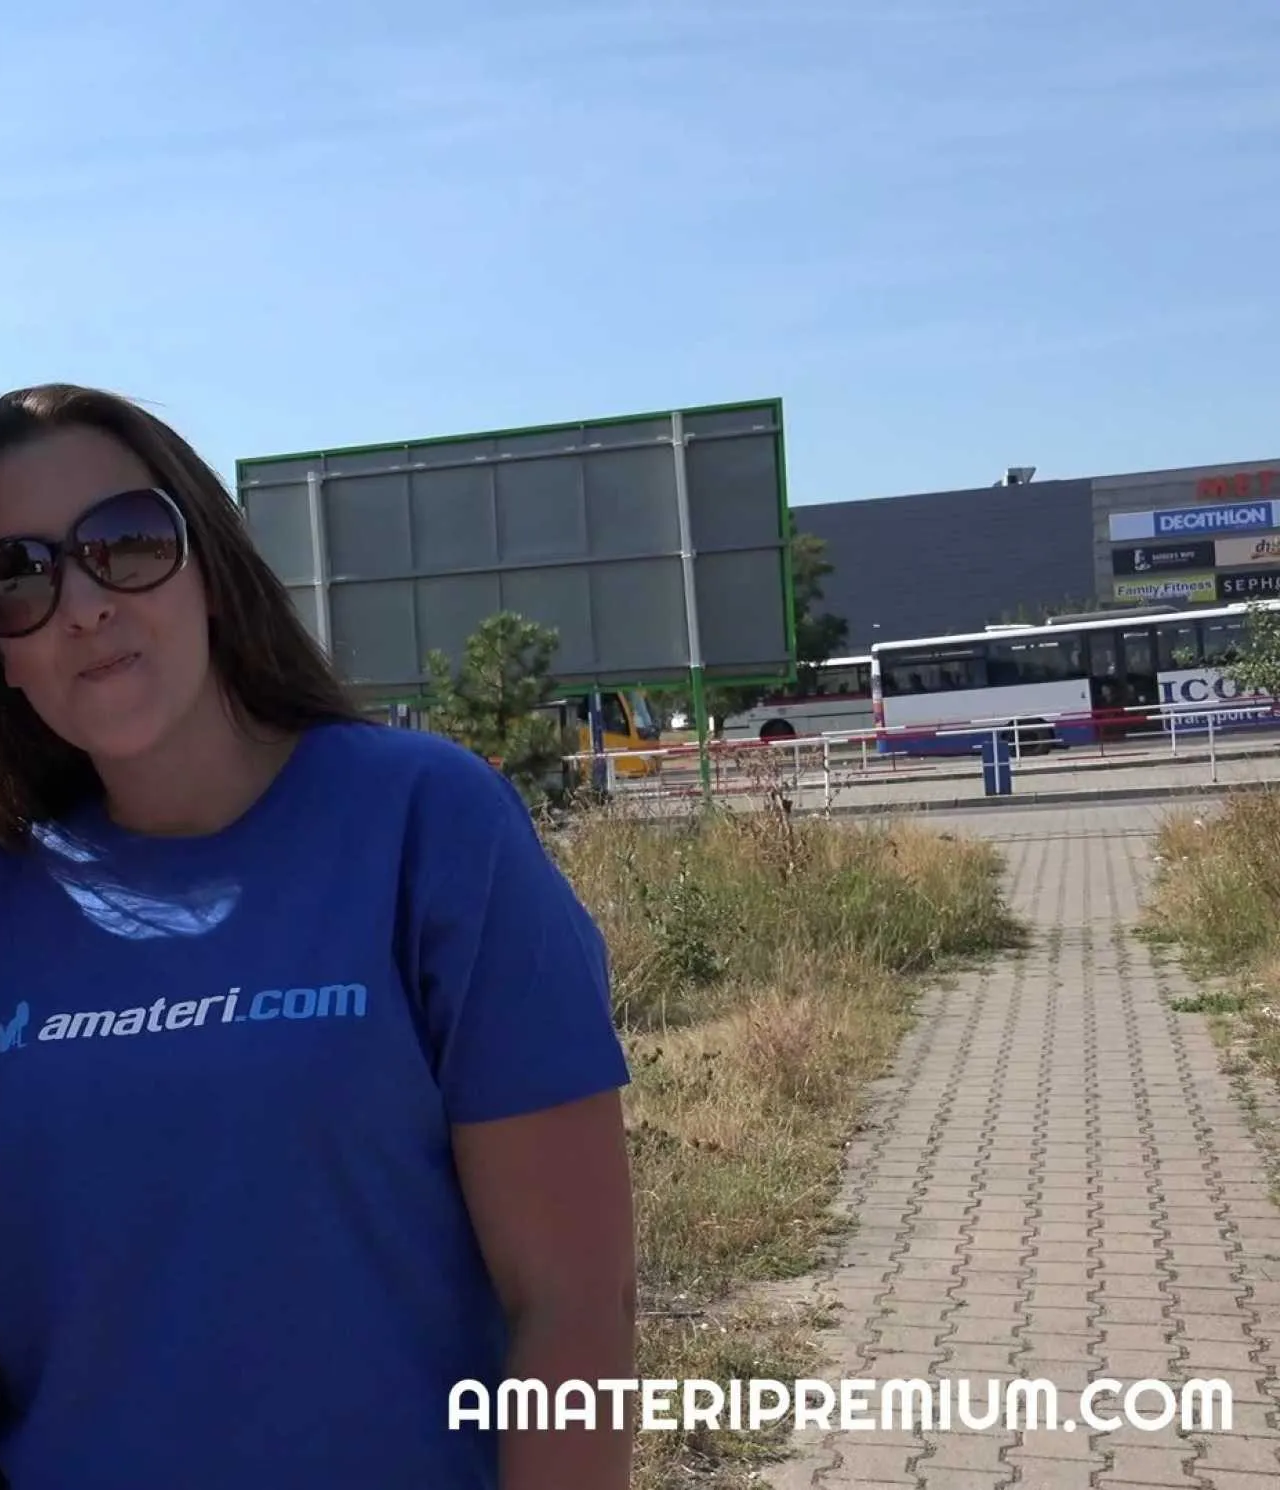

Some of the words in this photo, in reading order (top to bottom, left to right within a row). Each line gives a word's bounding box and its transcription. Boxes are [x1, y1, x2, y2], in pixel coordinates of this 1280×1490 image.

[1160, 507, 1266, 531] DECATHLON
[1118, 582, 1160, 597] Family
[1163, 580, 1213, 593] Fitness
[37, 983, 368, 1041] amateri.com
